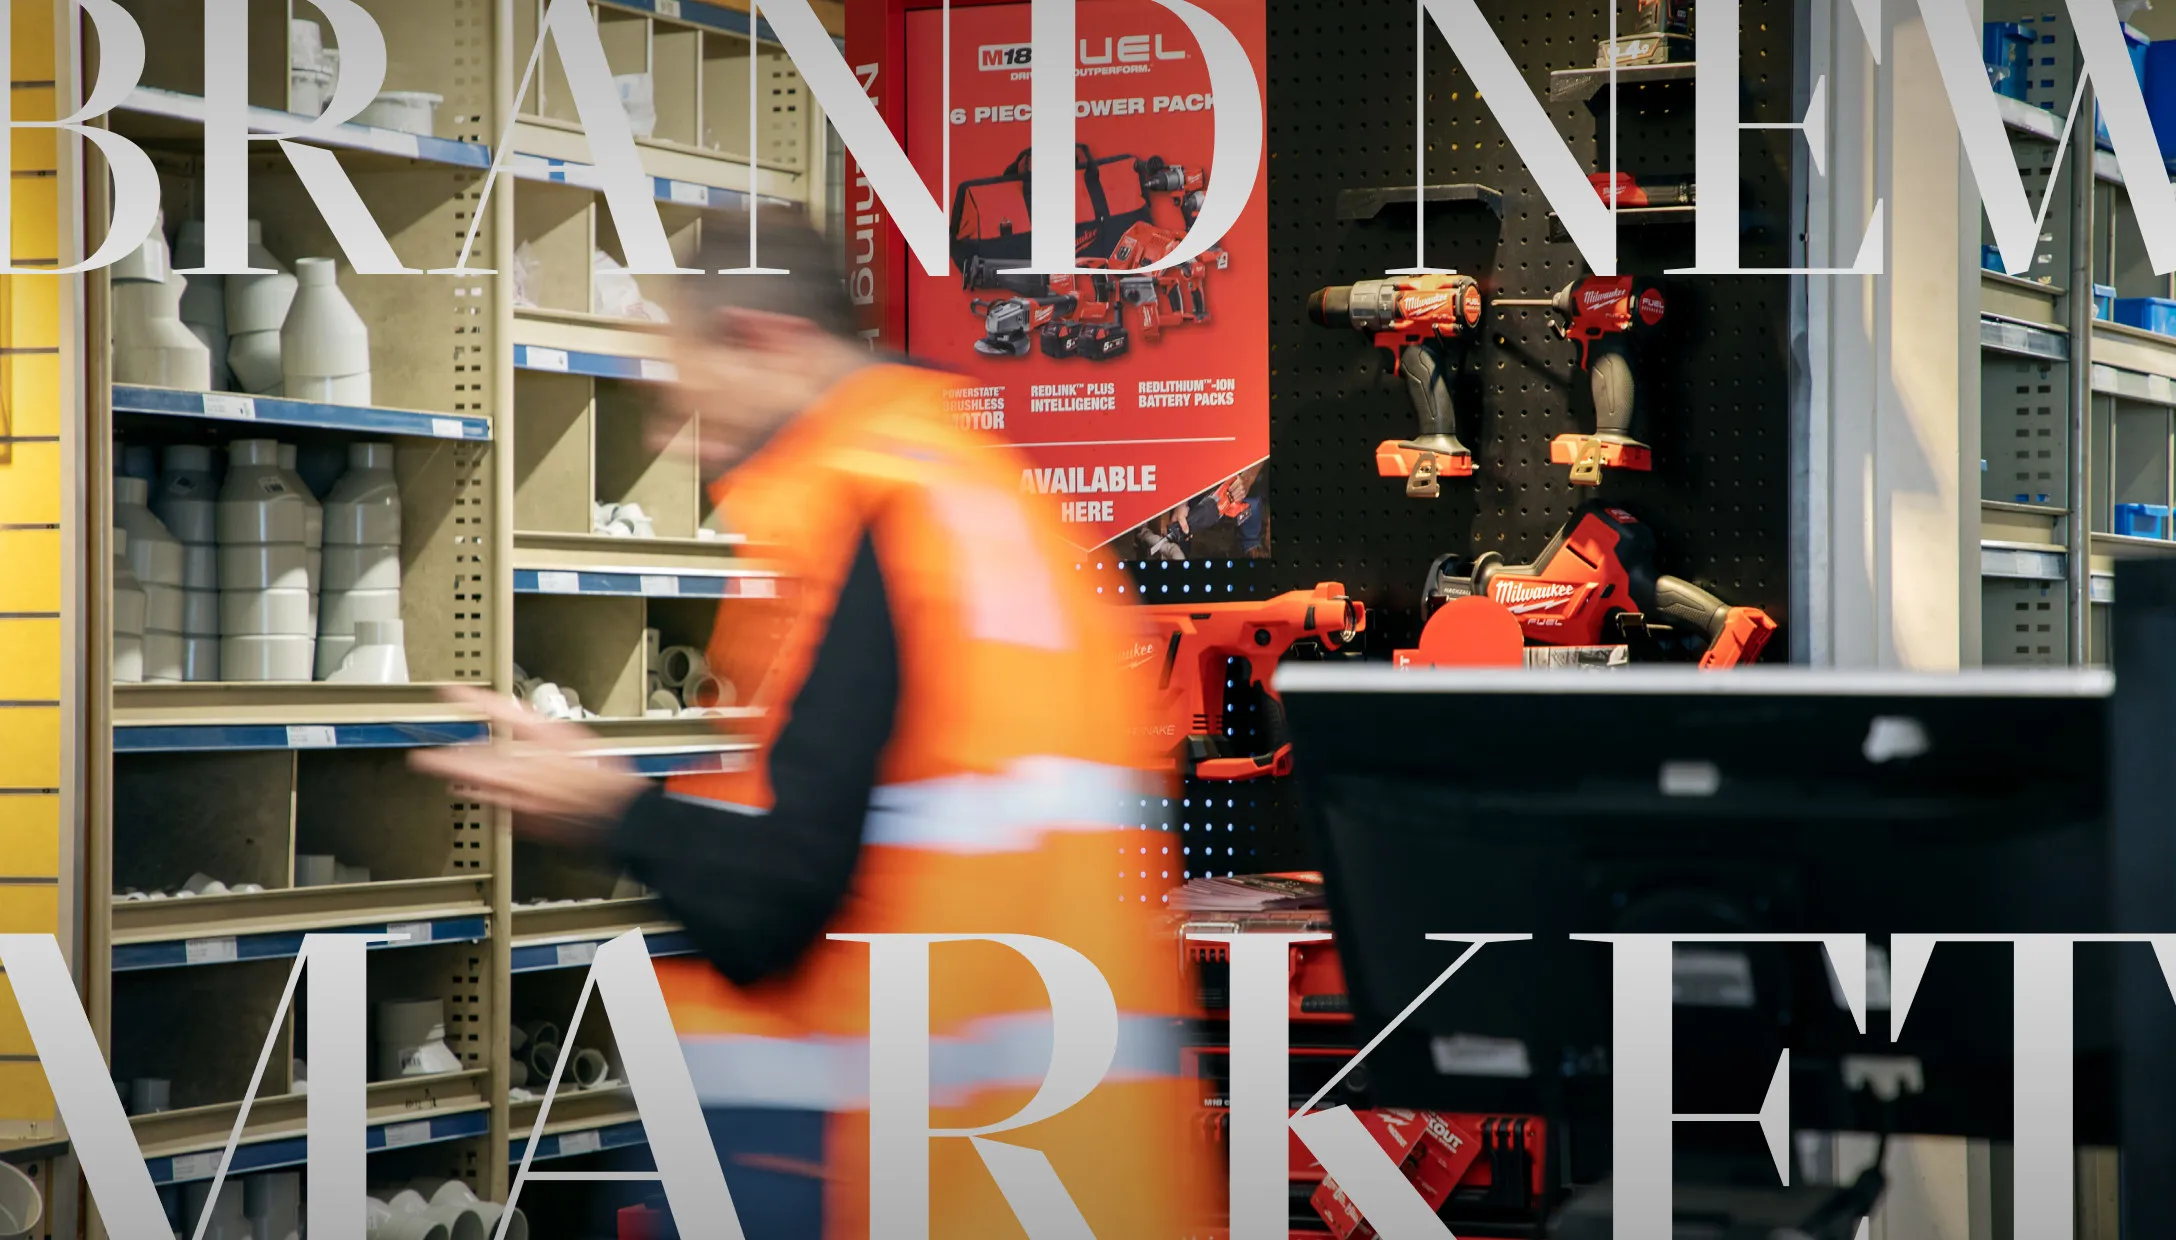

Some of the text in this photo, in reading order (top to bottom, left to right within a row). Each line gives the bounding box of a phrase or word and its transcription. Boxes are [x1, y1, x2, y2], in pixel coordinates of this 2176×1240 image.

[981, 33, 1186, 67] M18 UEL
[950, 108, 967, 125] 6
[974, 104, 1032, 123] PIEC
[1075, 97, 1145, 118] OWER
[1584, 287, 1626, 304] Milwaukee
[1642, 297, 1665, 308] FUEL
[1087, 383, 1115, 395] PLUS
[1031, 397, 1115, 412] INTELLIGENCE
[1138, 391, 1234, 408] BATTERY PACKS
[1019, 465, 1157, 494] AVAILABLE
[1061, 501, 1114, 522] HERE
[1495, 579, 1575, 604] Milwaukee
[1527, 617, 1563, 626] FUEL
